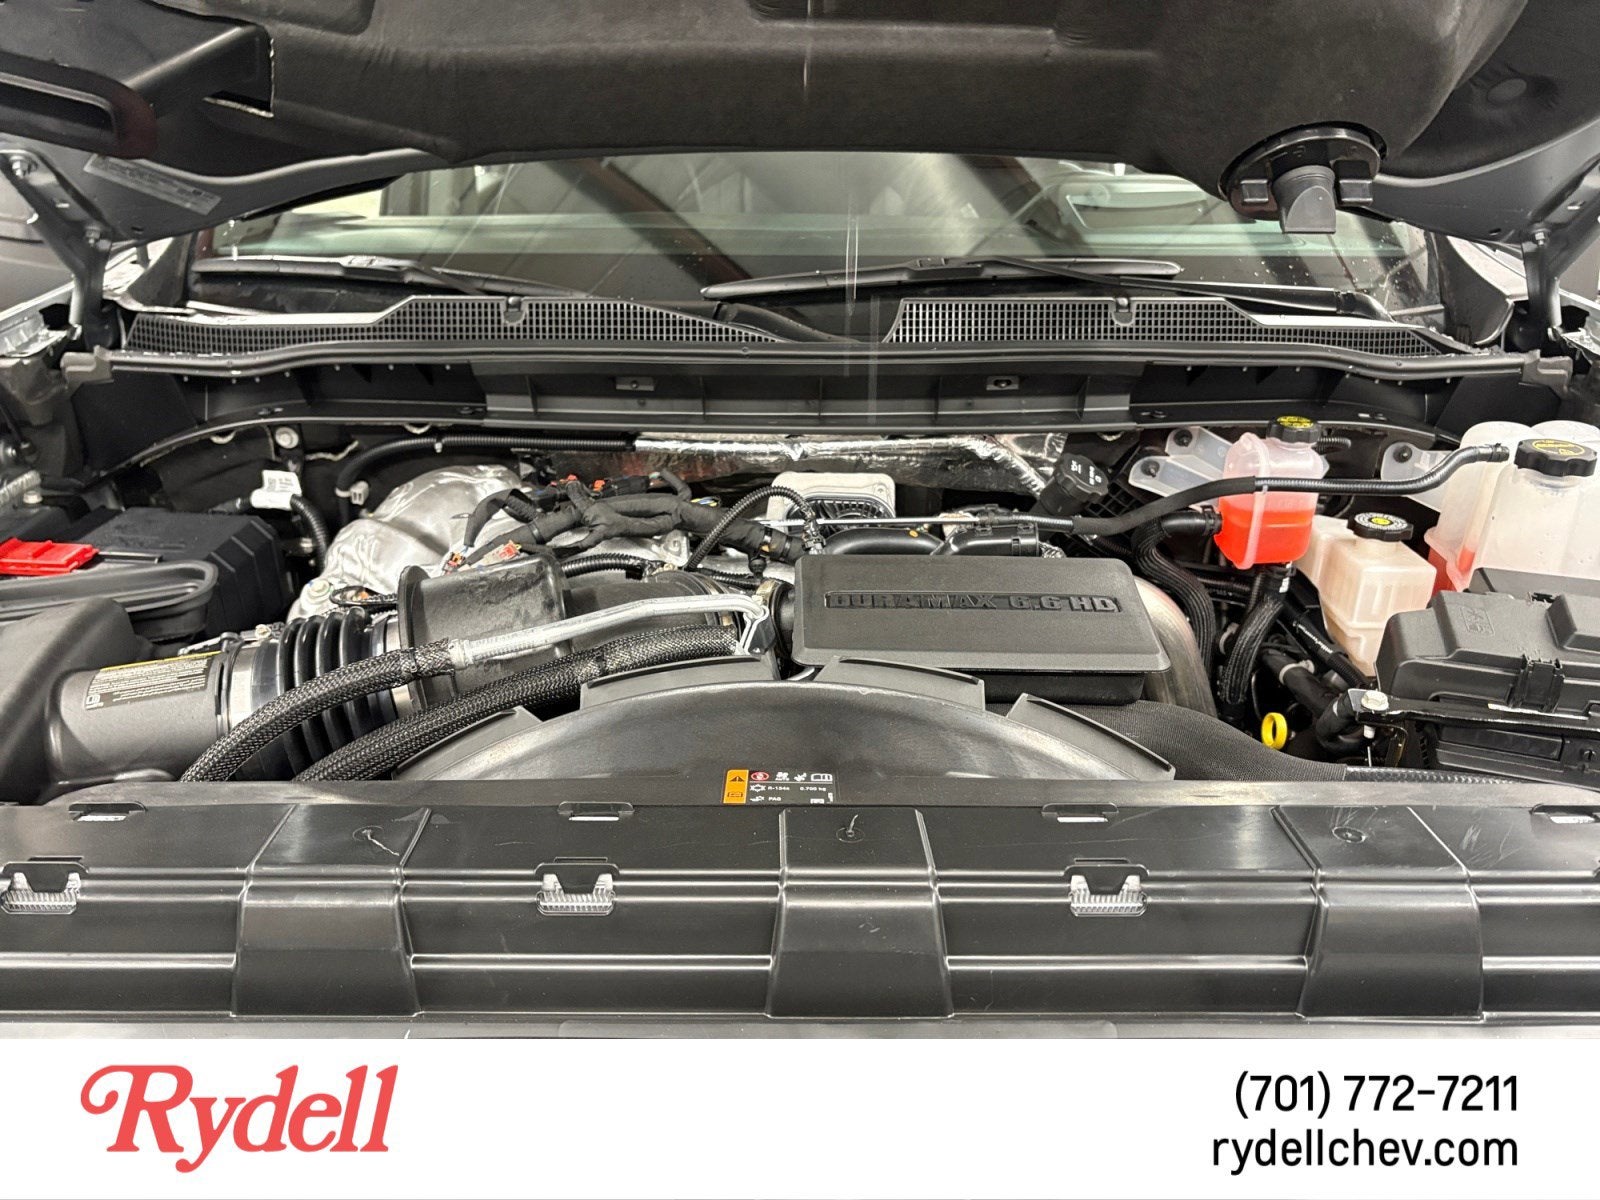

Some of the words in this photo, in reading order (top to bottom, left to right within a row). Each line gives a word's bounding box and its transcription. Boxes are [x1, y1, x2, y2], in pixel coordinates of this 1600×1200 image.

[827, 593, 997, 609] DURAMAX
[1009, 595, 1062, 610] 6.6
[1069, 596, 1118, 612] HD
